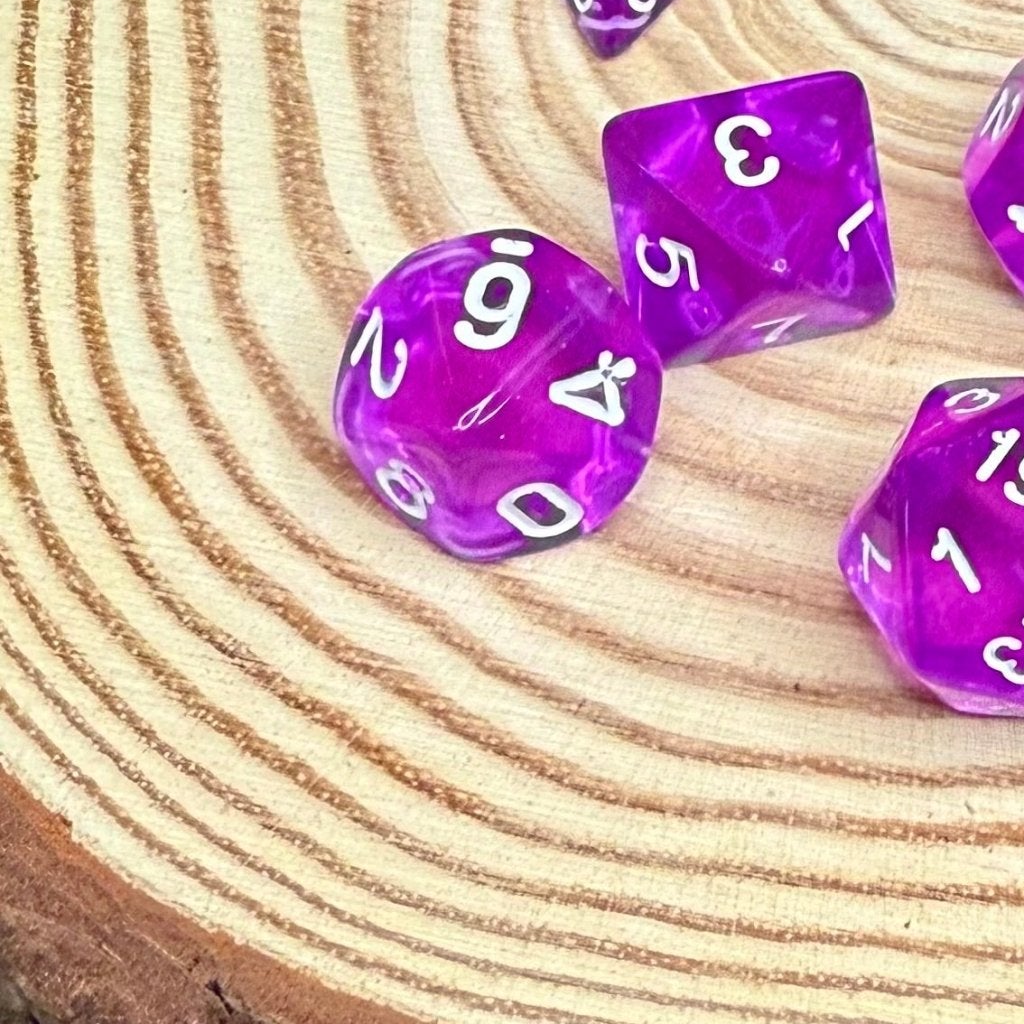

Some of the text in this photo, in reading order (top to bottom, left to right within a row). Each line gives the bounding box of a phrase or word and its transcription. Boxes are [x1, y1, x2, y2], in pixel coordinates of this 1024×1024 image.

[713, 114, 781, 188] 3
[634, 232, 701, 293] 5
[349, 305, 408, 399] 2
[547, 349, 637, 427] 4
[943, 387, 1001, 415] 3
[495, 481, 585, 539] 0
[929, 526, 982, 594] 1
